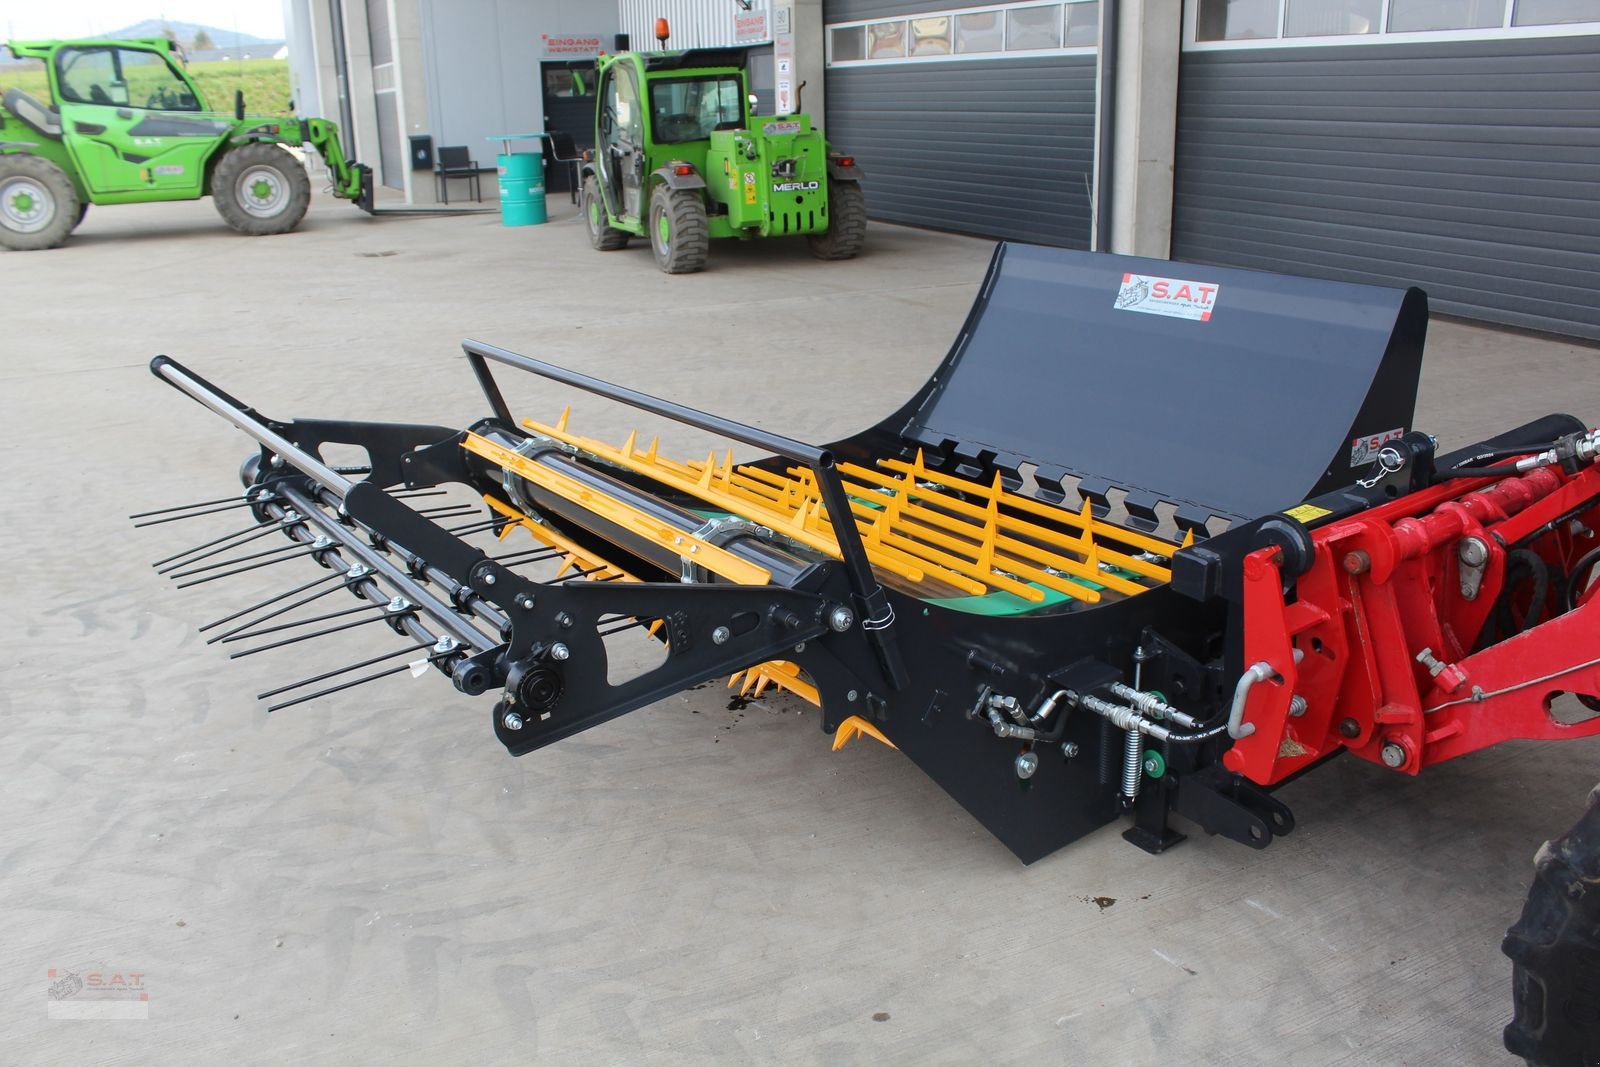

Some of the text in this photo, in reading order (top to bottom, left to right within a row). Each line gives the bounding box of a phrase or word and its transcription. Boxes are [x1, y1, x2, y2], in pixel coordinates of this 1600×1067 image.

[548, 38, 599, 46] EINGANG
[773, 181, 819, 193] MERLO
[1151, 281, 1215, 304] S.A.T.
